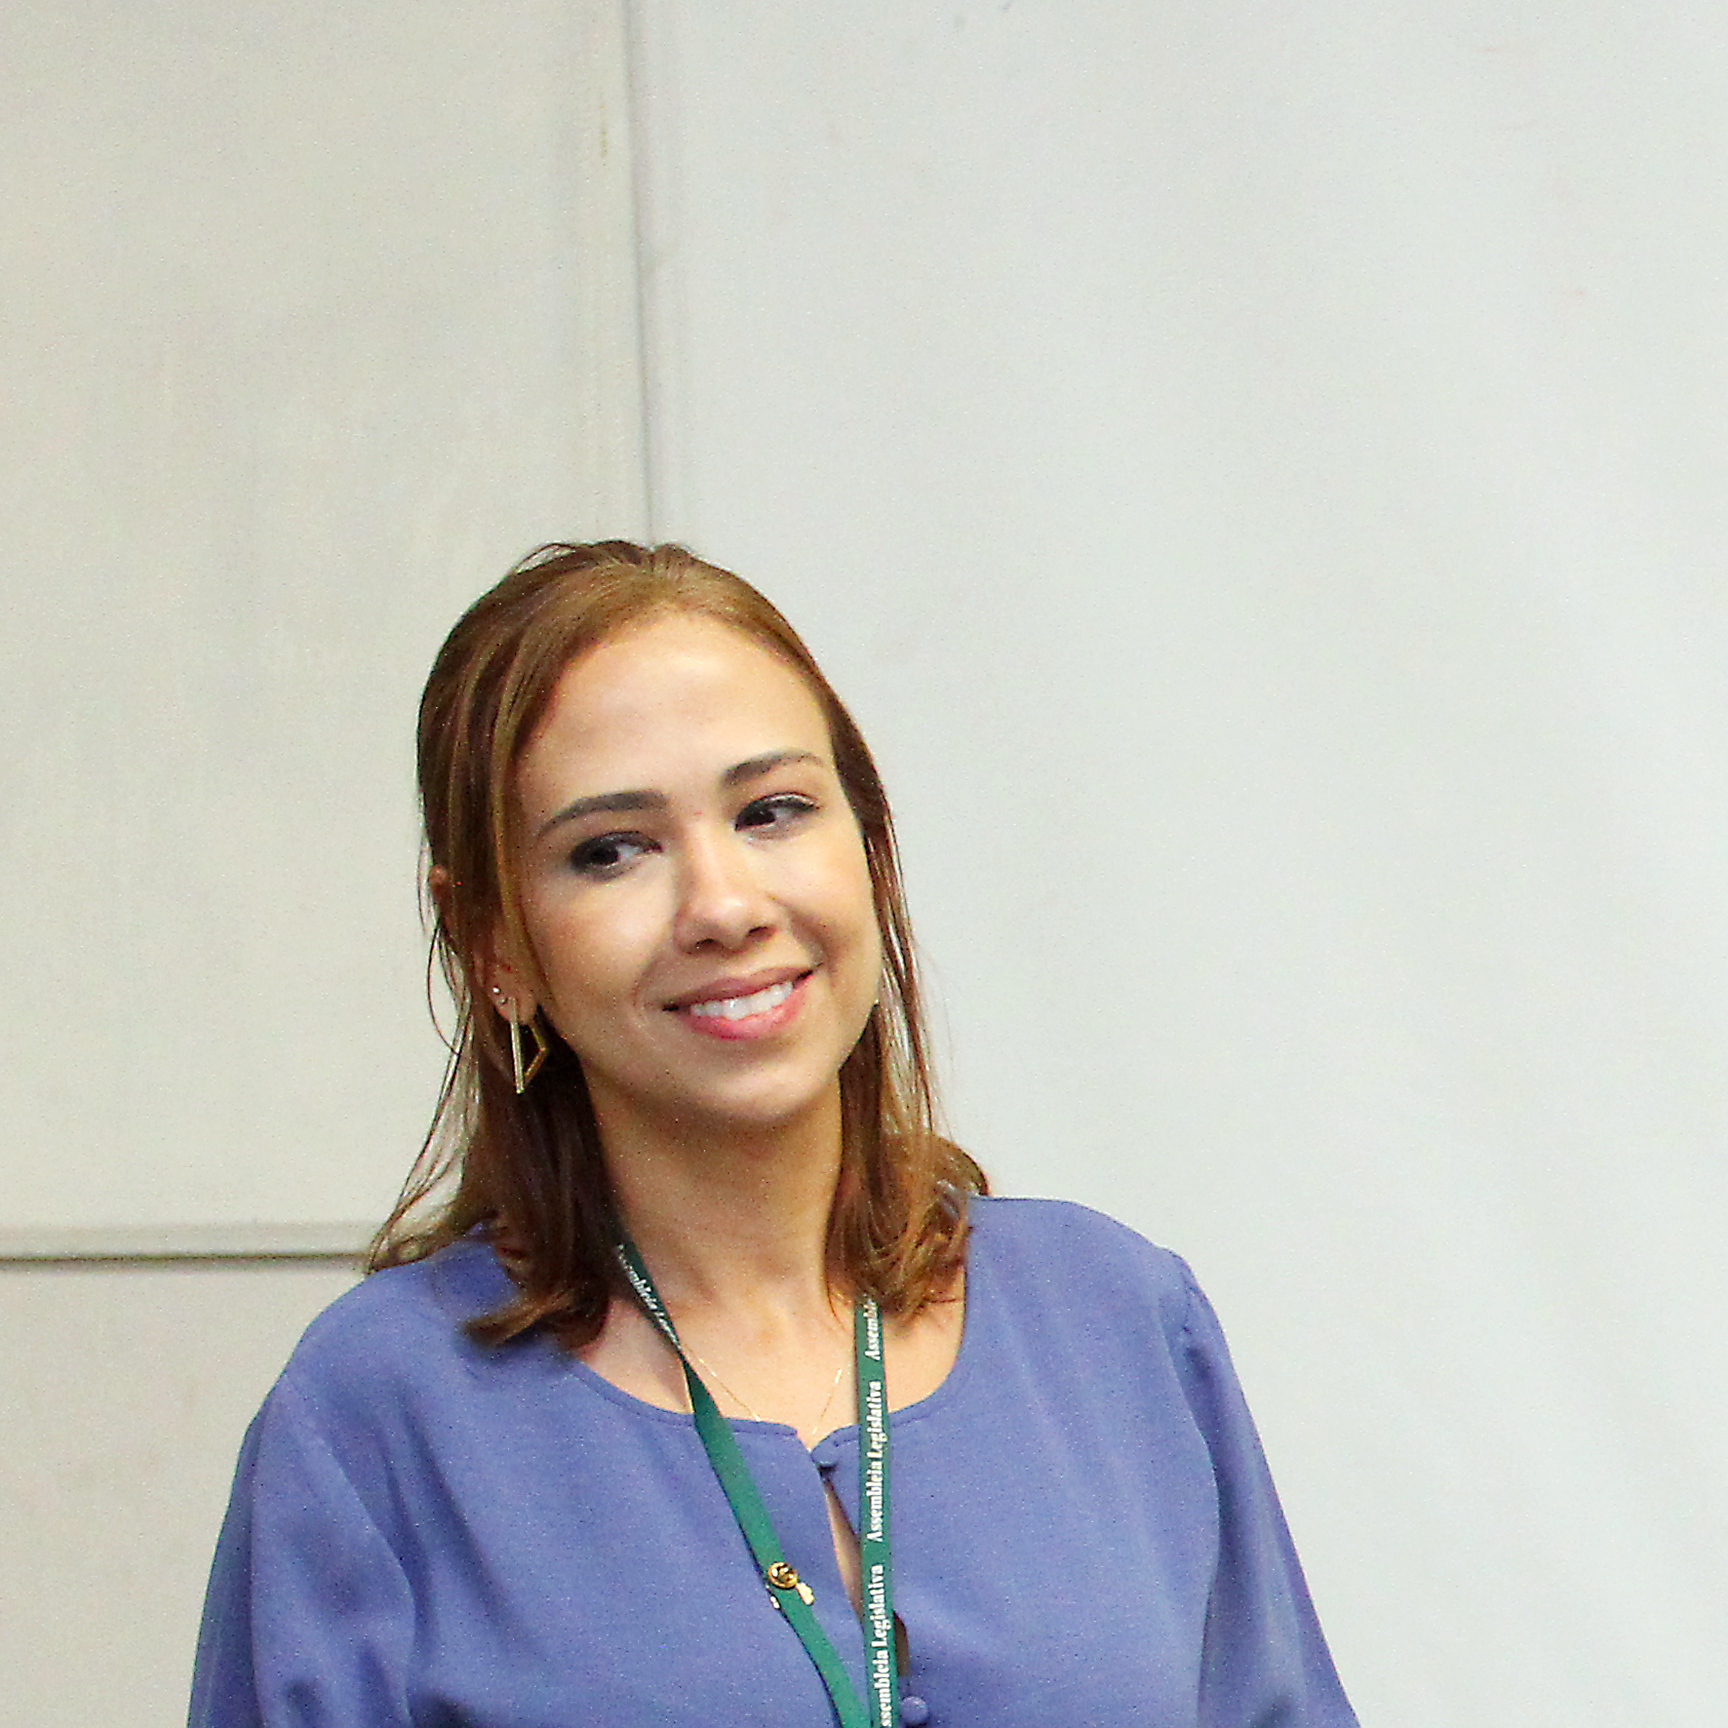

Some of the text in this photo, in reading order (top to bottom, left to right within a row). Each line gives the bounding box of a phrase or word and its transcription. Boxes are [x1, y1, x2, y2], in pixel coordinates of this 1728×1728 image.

[866, 1381, 887, 1542] Assembleia Legislativa
[869, 1564, 891, 1647] Legislativa
